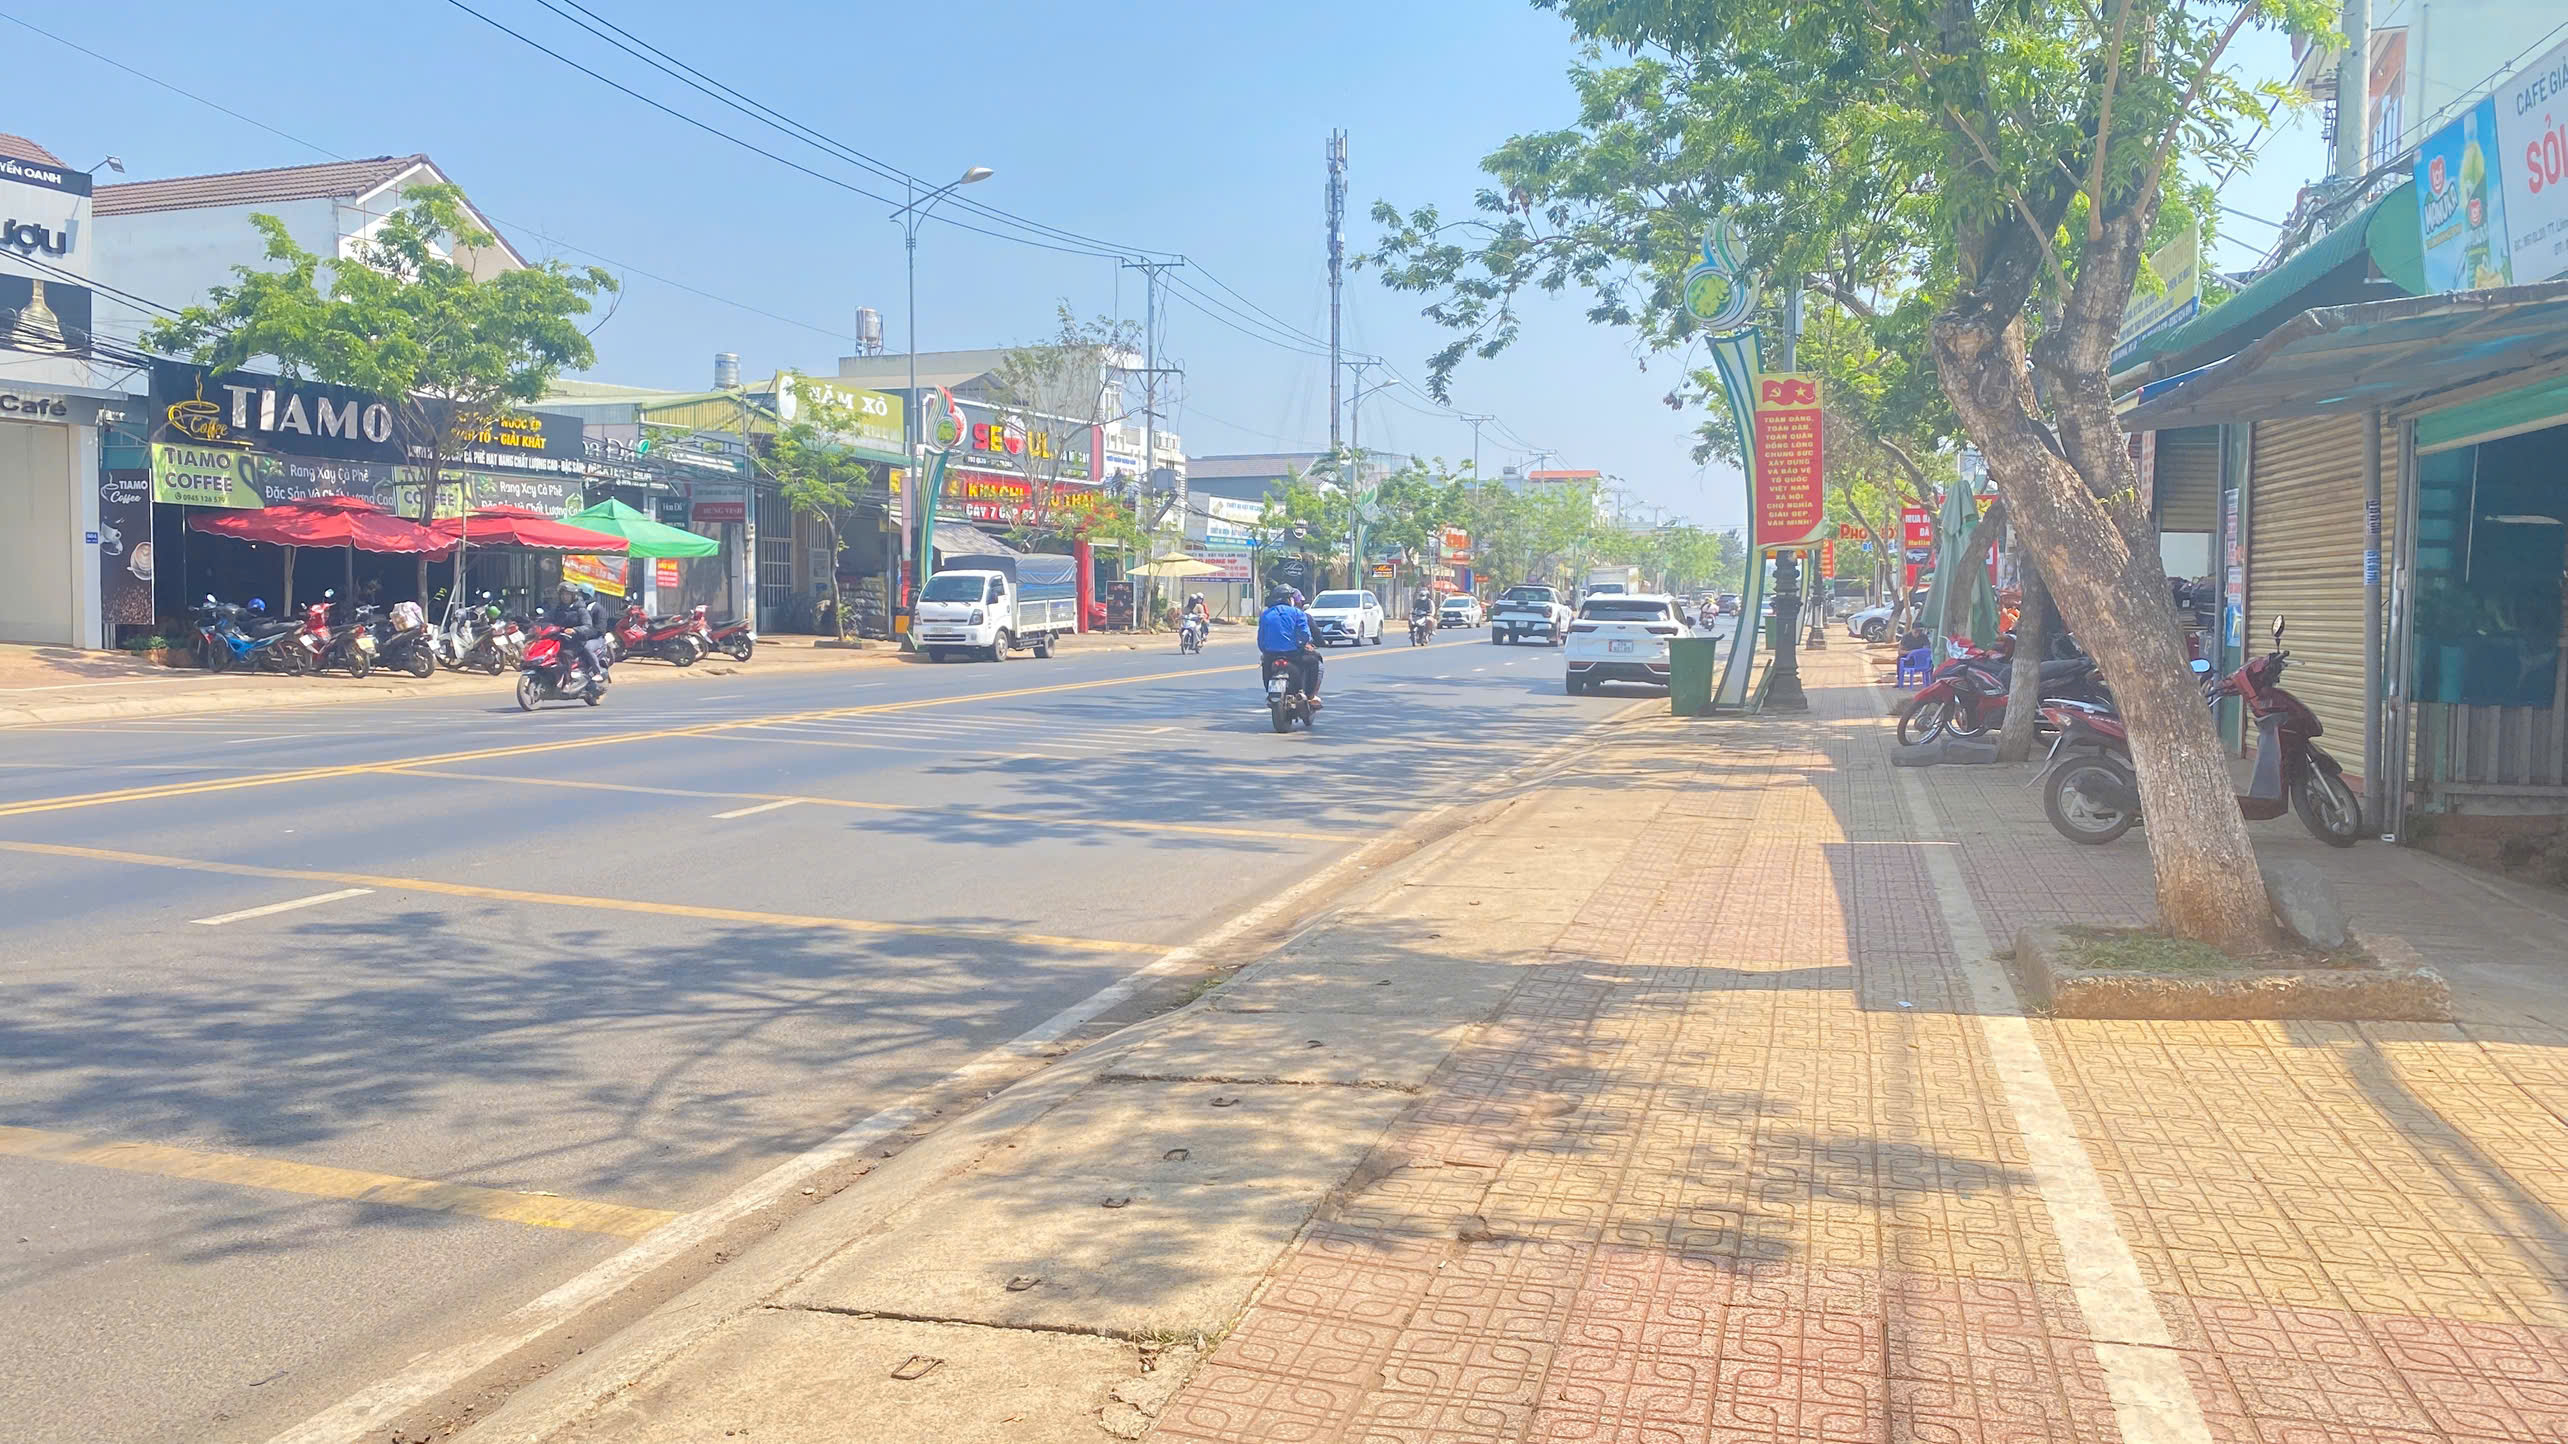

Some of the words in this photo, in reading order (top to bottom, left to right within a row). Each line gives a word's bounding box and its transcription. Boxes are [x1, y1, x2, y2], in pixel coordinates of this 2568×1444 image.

[24, 168, 62, 184] OANH
[0, 395, 67, 416] Café
[223, 384, 393, 443] TIAMO
[163, 446, 231, 470] TIAMO
[165, 472, 232, 492] COFFEE
[290, 464, 315, 483] Rang
[317, 466, 336, 485] Xay
[119, 480, 148, 490] TIAMO
[500, 481, 520, 498] Rang
[110, 490, 142, 504] Coffee
[265, 486, 286, 502] Đặc
[376, 493, 394, 506] Cao
